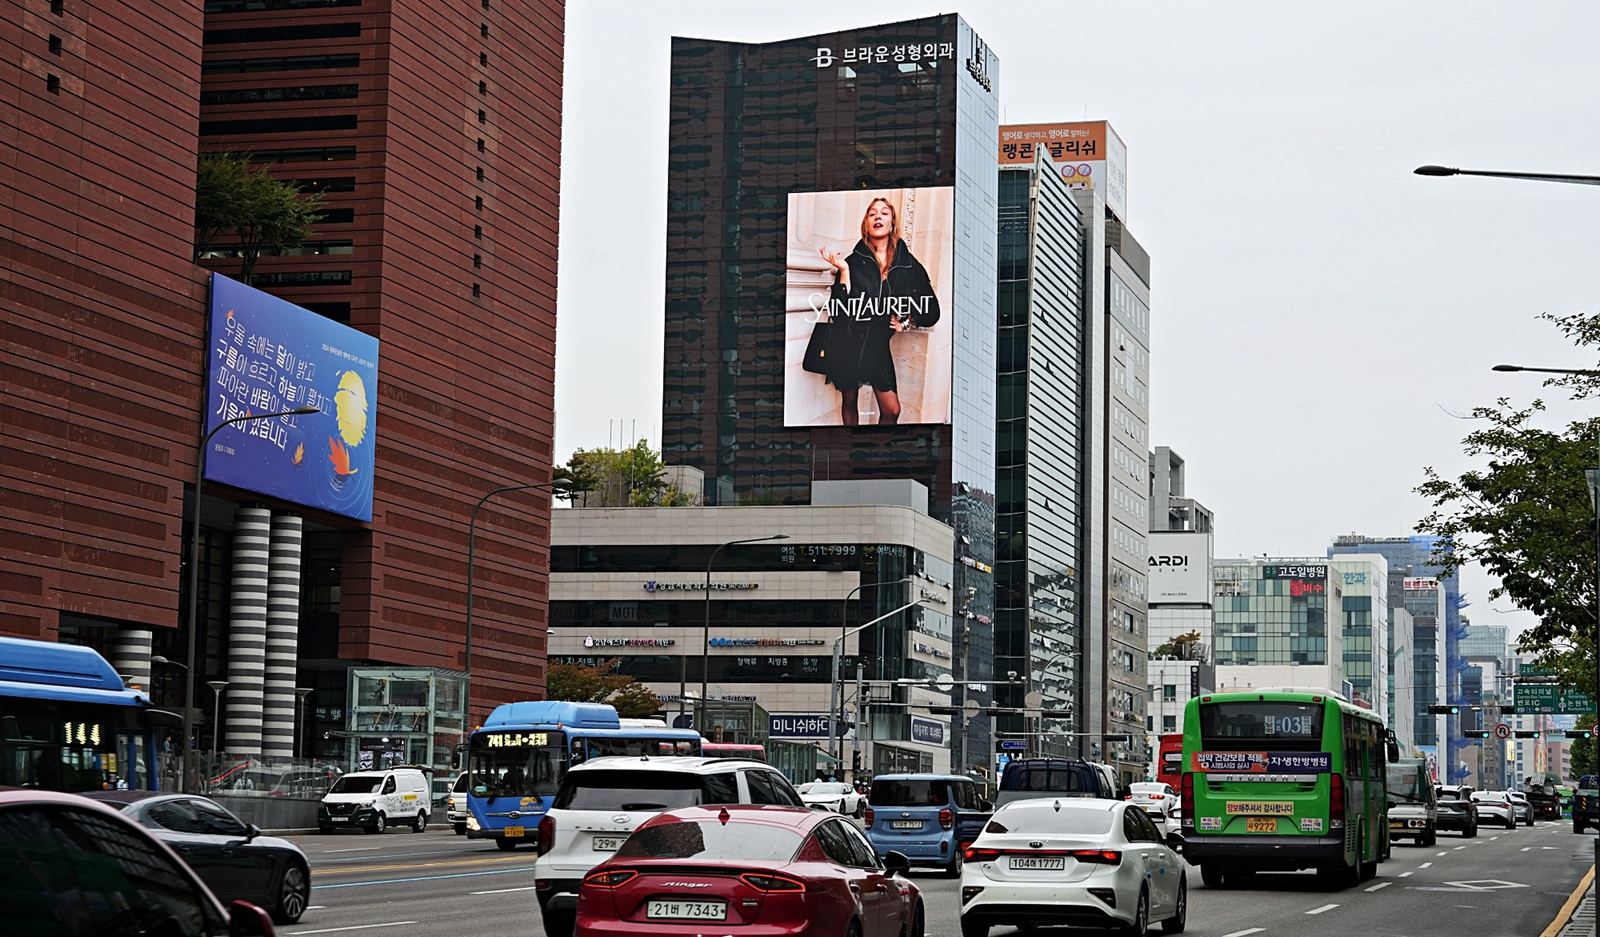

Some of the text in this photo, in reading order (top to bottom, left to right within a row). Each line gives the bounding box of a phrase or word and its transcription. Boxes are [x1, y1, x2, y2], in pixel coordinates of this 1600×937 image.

[842, 42, 954, 65] 브라운성형외과
[1002, 131, 1023, 140] 영어로
[1048, 129, 1069, 138] 영어로
[1002, 140, 1096, 159] 랭콘글리쉬
[225, 317, 245, 348] 우물
[247, 334, 275, 361] 속에는
[276, 344, 296, 376] 달이
[296, 360, 316, 382] 밝고
[216, 338, 332, 416] 구름이 흐르고 하늘이 펼치고
[217, 366, 249, 405] 파아란
[250, 387, 279, 414] 바람이
[216, 394, 288, 451] 가을이 있습니다
[1147, 556, 1188, 566] ARDI
[1278, 567, 1325, 578] 고도일병원
[1344, 572, 1367, 585] 안과
[1282, 717, 1301, 733] 03
[65, 721, 101, 745] 144
[487, 735, 503, 747] 741
[1215, 753, 1246, 762] 건강보험
[1247, 753, 1263, 763] 적용
[1271, 757, 1328, 767] 자생한방병원
[1226, 803, 1293, 813] 양보해주셔서 감사합니다
[1038, 859, 1060, 867] 1777
[654, 903, 719, 917] 21버 7343
